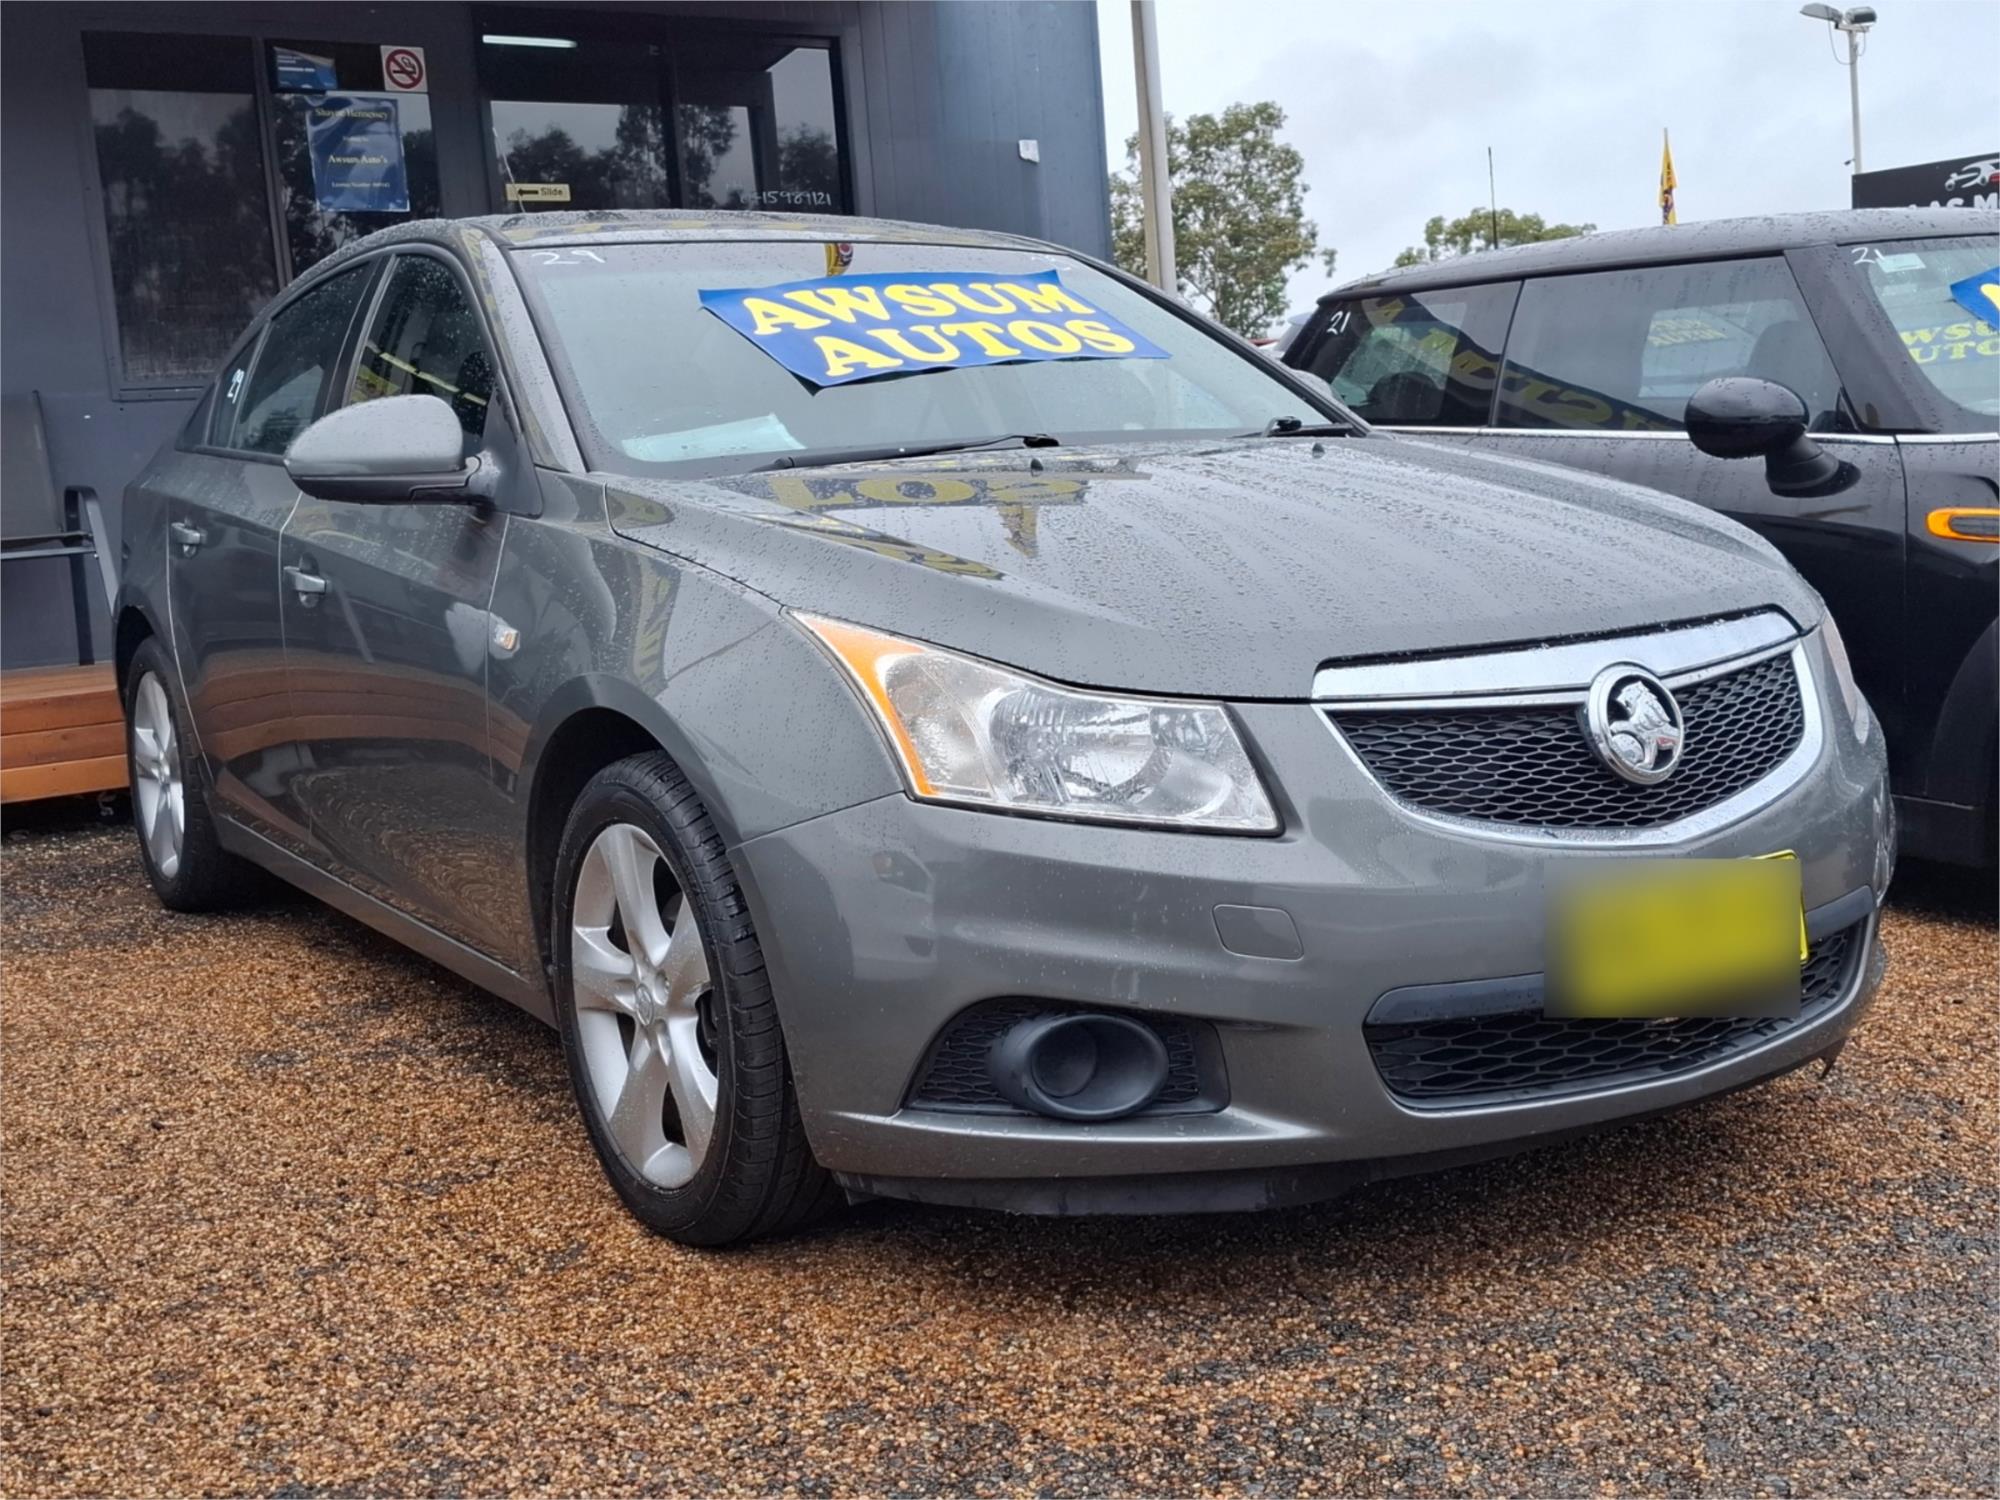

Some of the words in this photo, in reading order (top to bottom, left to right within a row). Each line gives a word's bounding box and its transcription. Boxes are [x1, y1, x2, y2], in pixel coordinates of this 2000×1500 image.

[540, 187, 564, 197] Slide
[743, 283, 1096, 335] AWSUM
[1326, 310, 1352, 335] 21
[813, 320, 1135, 376] AUTOS
